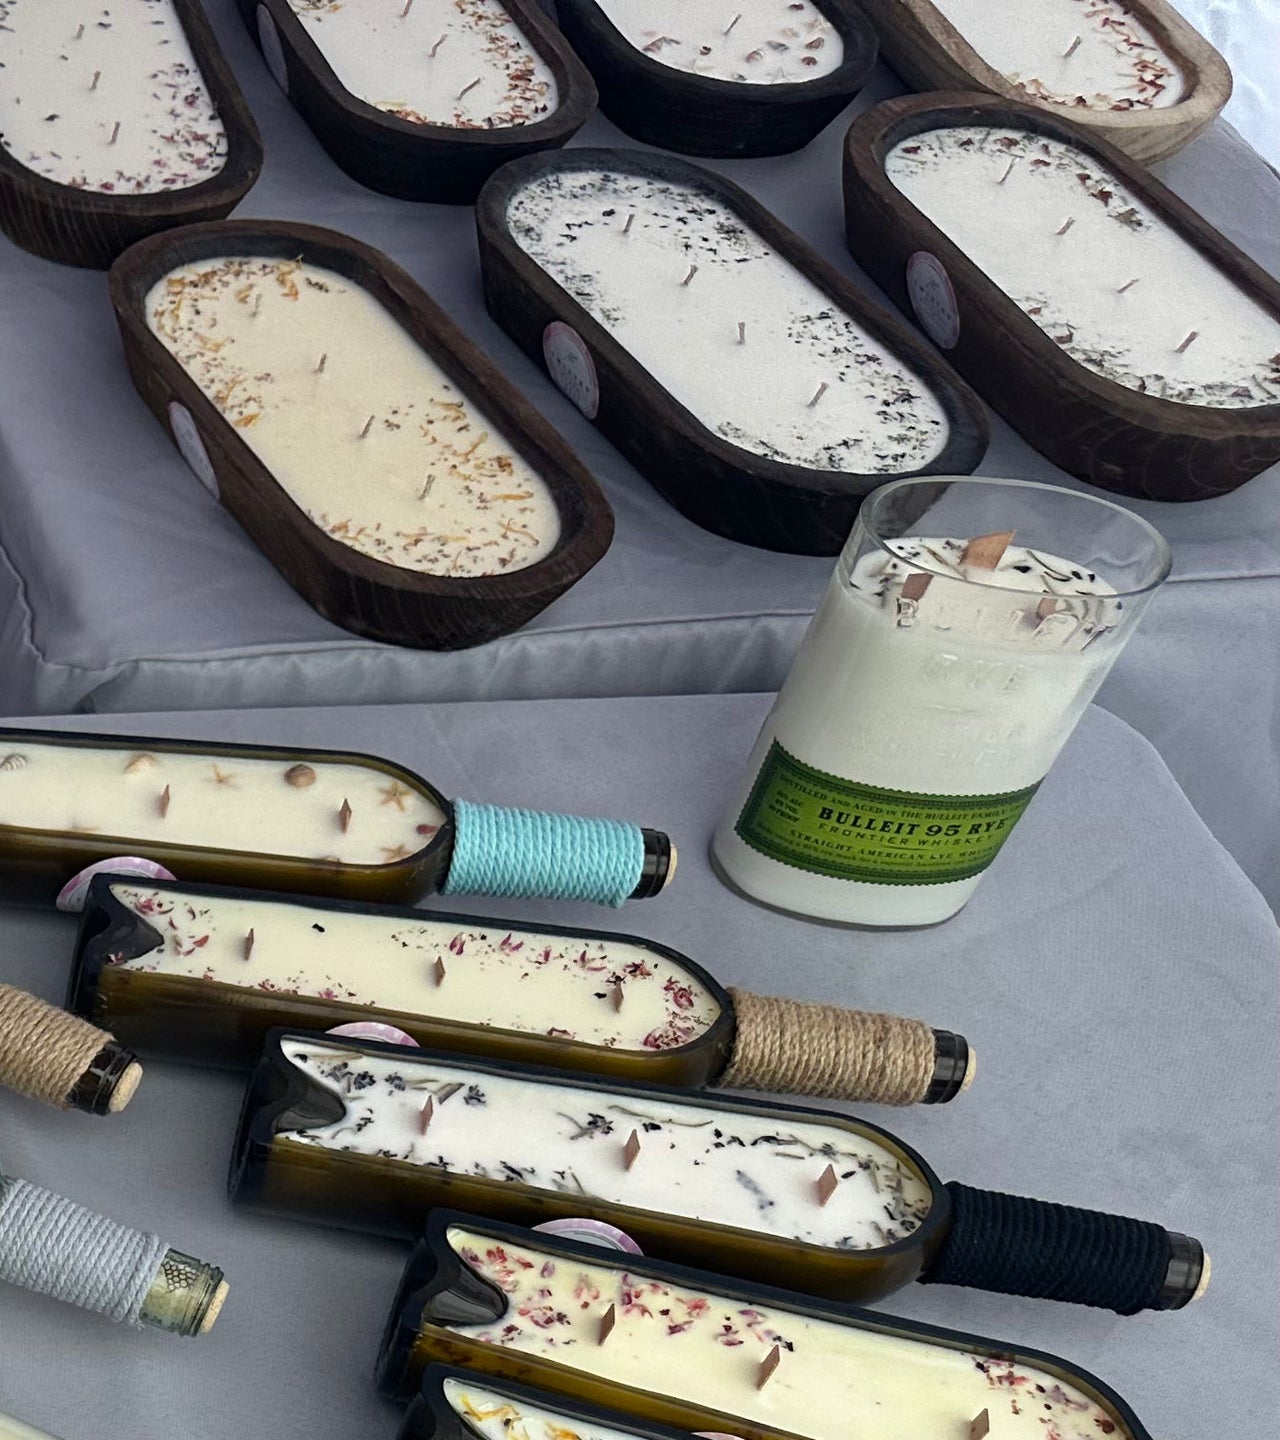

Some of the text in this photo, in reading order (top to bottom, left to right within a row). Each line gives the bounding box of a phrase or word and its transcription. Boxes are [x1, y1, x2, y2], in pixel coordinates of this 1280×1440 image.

[818, 806, 1009, 837] BULLEIT 95 RYE
[853, 803, 884, 816] AGED
[901, 810, 922, 819] THE
[789, 829, 853, 853] STRAIGHT
[858, 846, 925, 861] AMERICAN
[818, 822, 994, 847] FRONTIER WHISKEY
